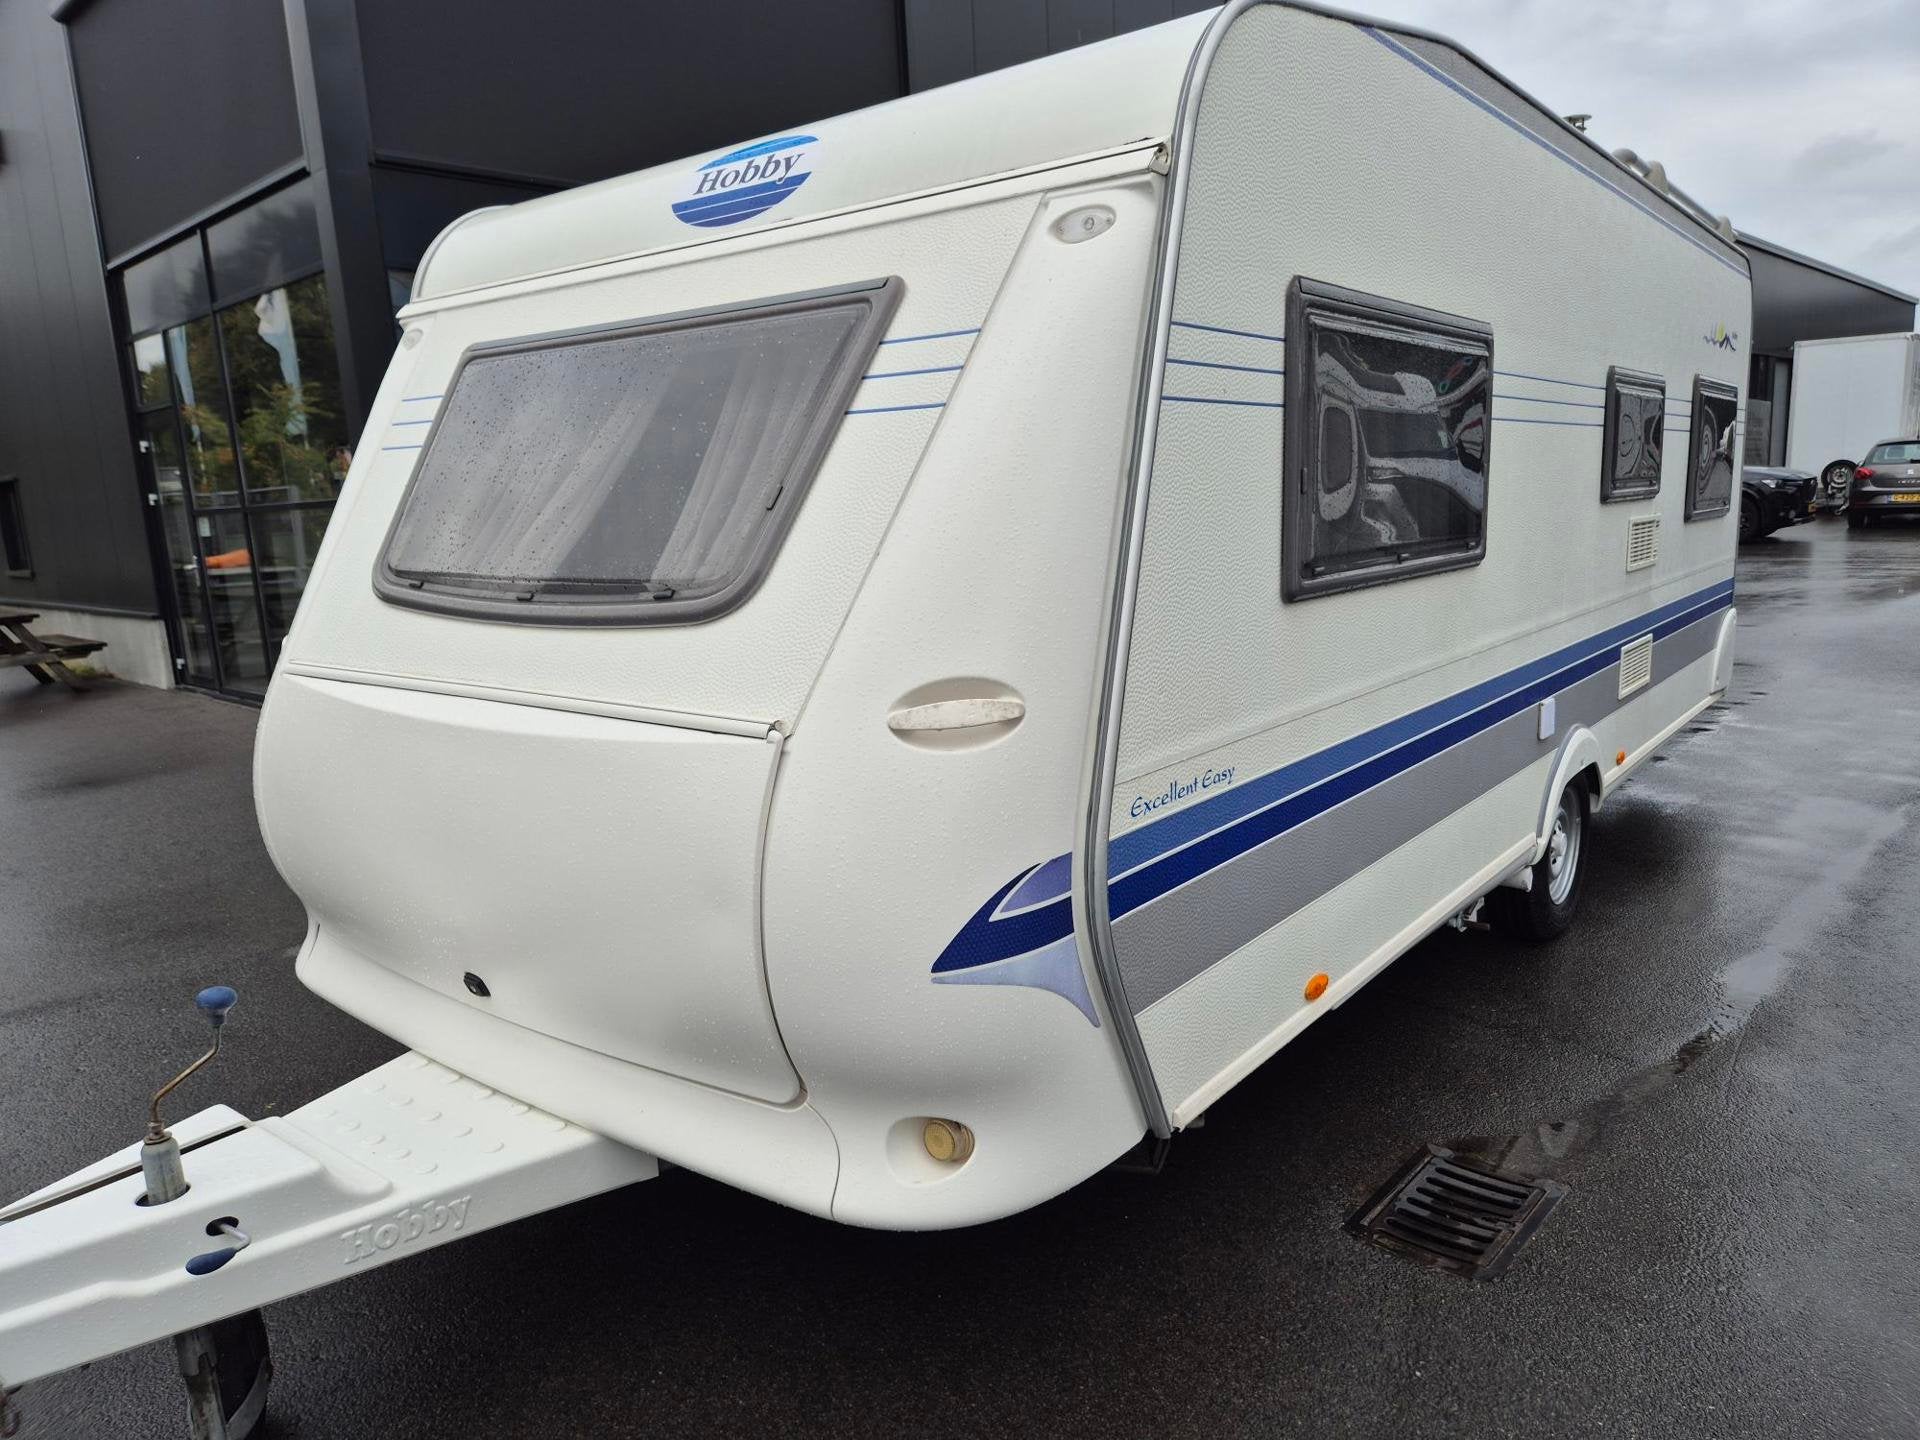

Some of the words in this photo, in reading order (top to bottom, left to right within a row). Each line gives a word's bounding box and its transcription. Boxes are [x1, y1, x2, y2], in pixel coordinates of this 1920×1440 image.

[692, 152, 806, 196] Hobby
[1130, 777, 1199, 818] Excellent
[1201, 766, 1236, 789] Easy
[339, 1194, 472, 1265] Hobby
